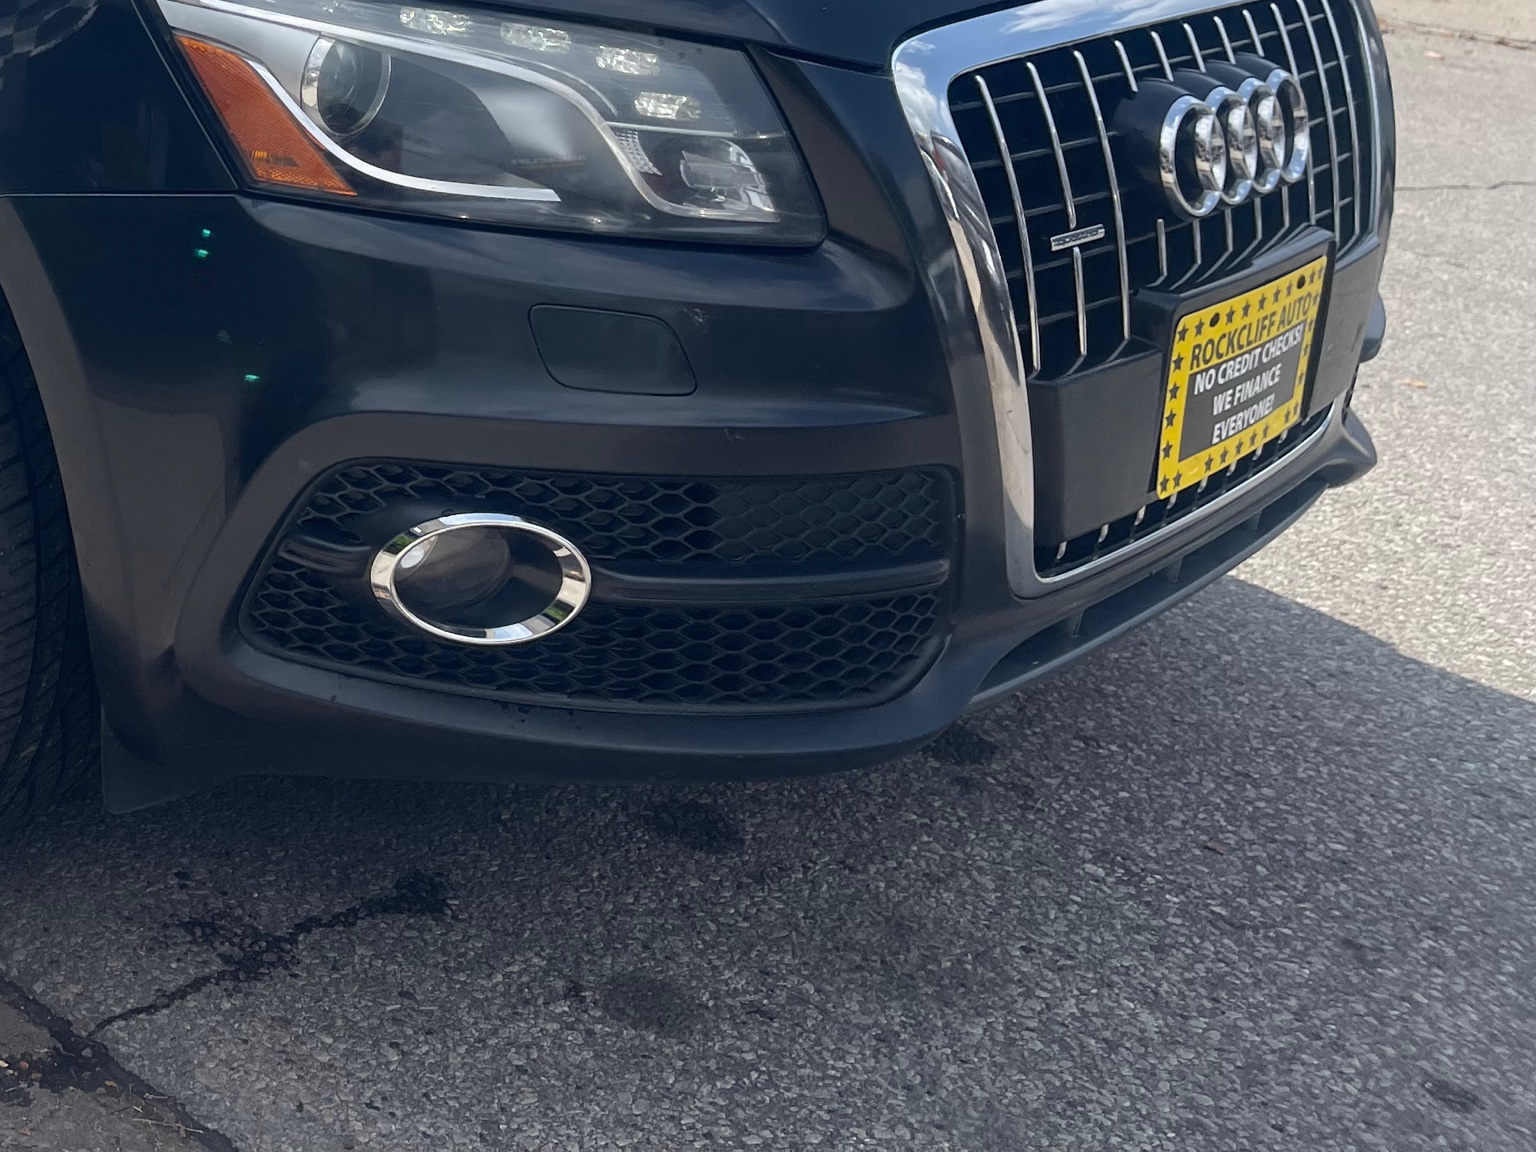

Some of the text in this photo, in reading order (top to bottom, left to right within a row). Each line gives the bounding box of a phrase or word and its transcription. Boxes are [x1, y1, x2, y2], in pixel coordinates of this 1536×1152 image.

[1190, 295, 1312, 371] ROCKCLIFF AUTO
[1194, 323, 1303, 395] NO CREDIT CHECKS!
[1212, 393, 1275, 445] EVERYONE!
[1213, 363, 1282, 416] WE FINANCE
